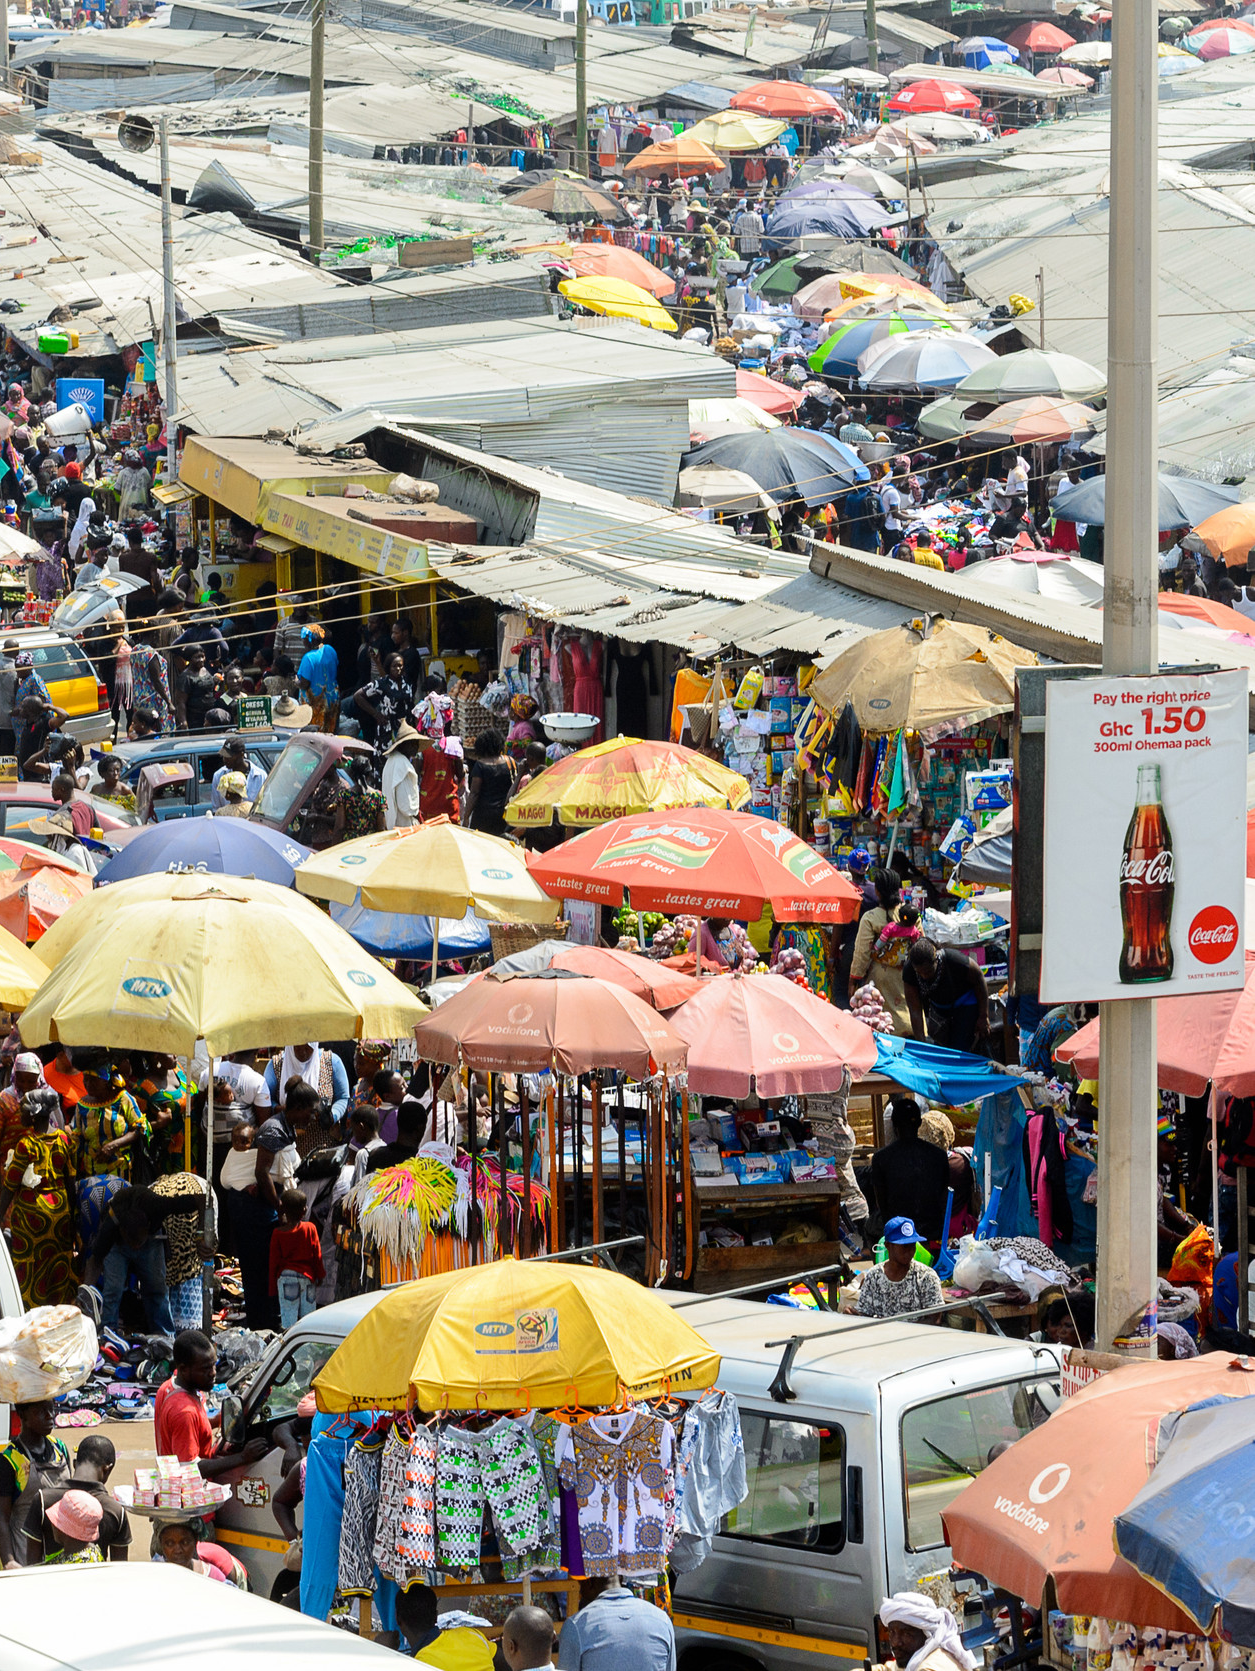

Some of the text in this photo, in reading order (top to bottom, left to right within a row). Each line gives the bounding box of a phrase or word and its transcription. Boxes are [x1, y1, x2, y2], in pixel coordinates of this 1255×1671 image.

[1093, 690, 1211, 706] Pay the right price
[1099, 706, 1206, 737] Ghc 1.50
[1094, 736, 1212, 752] 300ml Ohemaa pack
[575, 806, 627, 820] MAGGI
[651, 844, 683, 863] Noodles
[487, 870, 508, 879] MTN
[641, 859, 675, 876] great
[546, 879, 610, 896] ...tastes great
[653, 891, 741, 911] ...tastes great
[783, 900, 841, 914] ...tastes great
[130, 980, 166, 995] MTN
[488, 1025, 541, 1037] vodafone
[768, 1053, 824, 1065] vodafone
[482, 1324, 507, 1334] MTN
[993, 1495, 1050, 1535] vodafone
